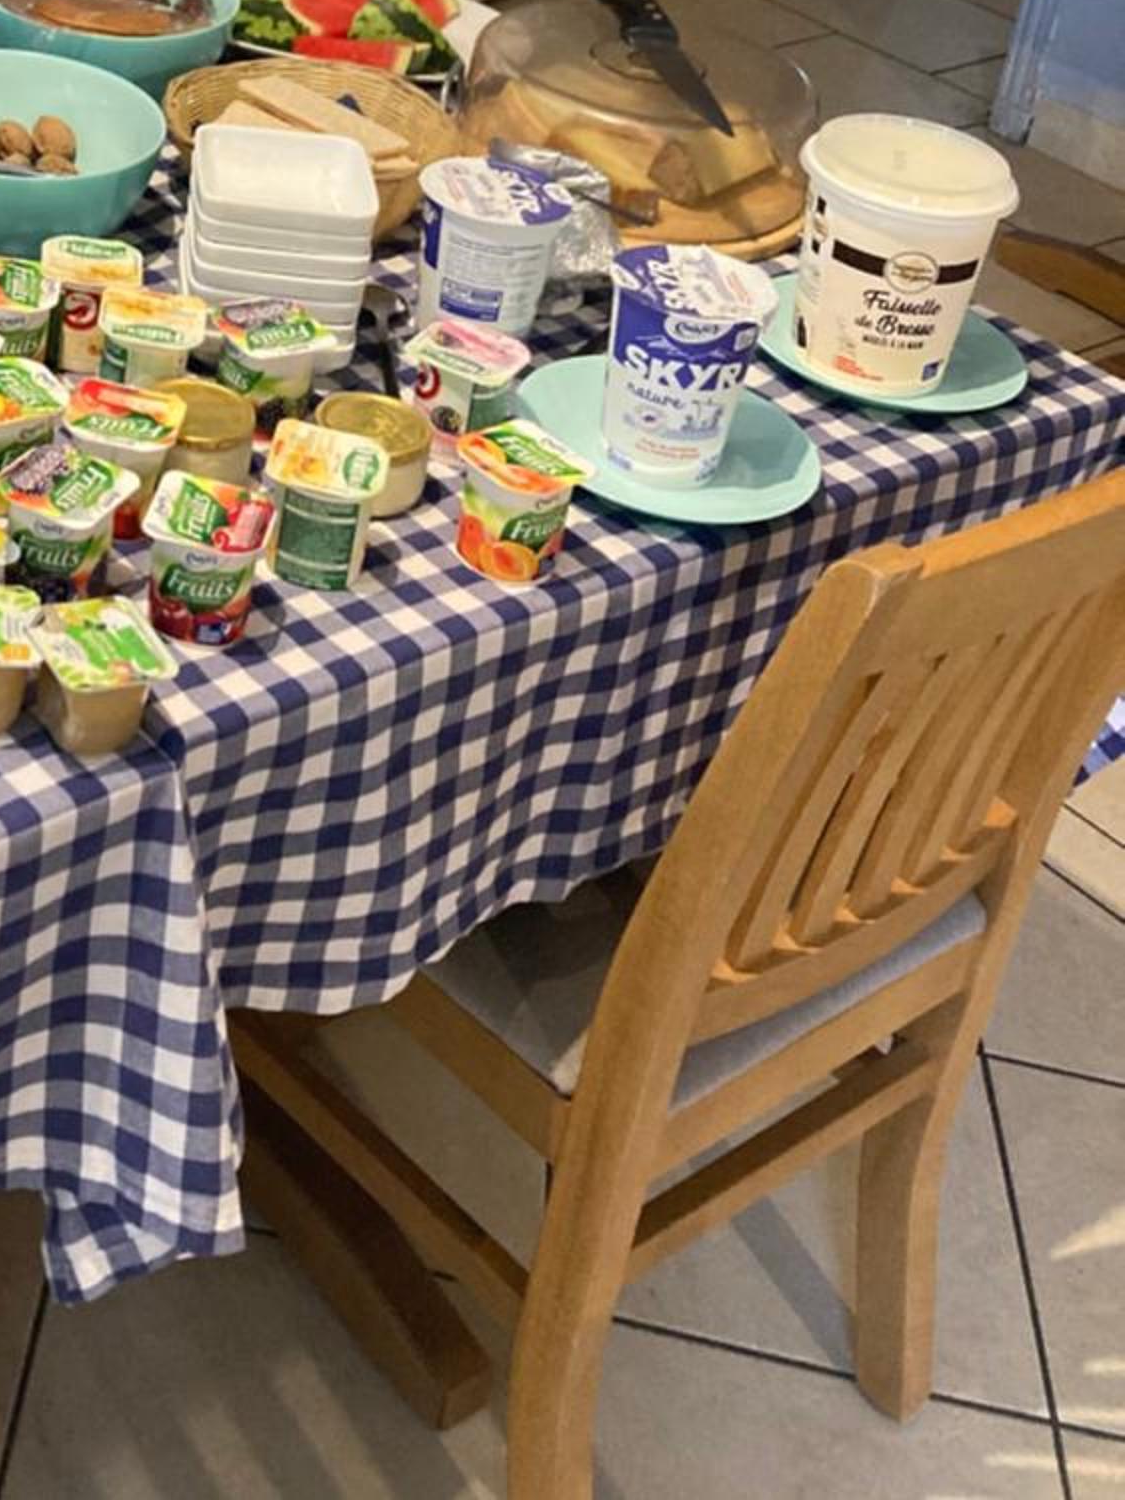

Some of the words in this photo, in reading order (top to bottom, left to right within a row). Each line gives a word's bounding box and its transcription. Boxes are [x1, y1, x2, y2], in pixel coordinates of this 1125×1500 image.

[862, 289, 942, 316] Faisselle
[623, 344, 743, 393] SKYR
[165, 566, 237, 599] Fruits
